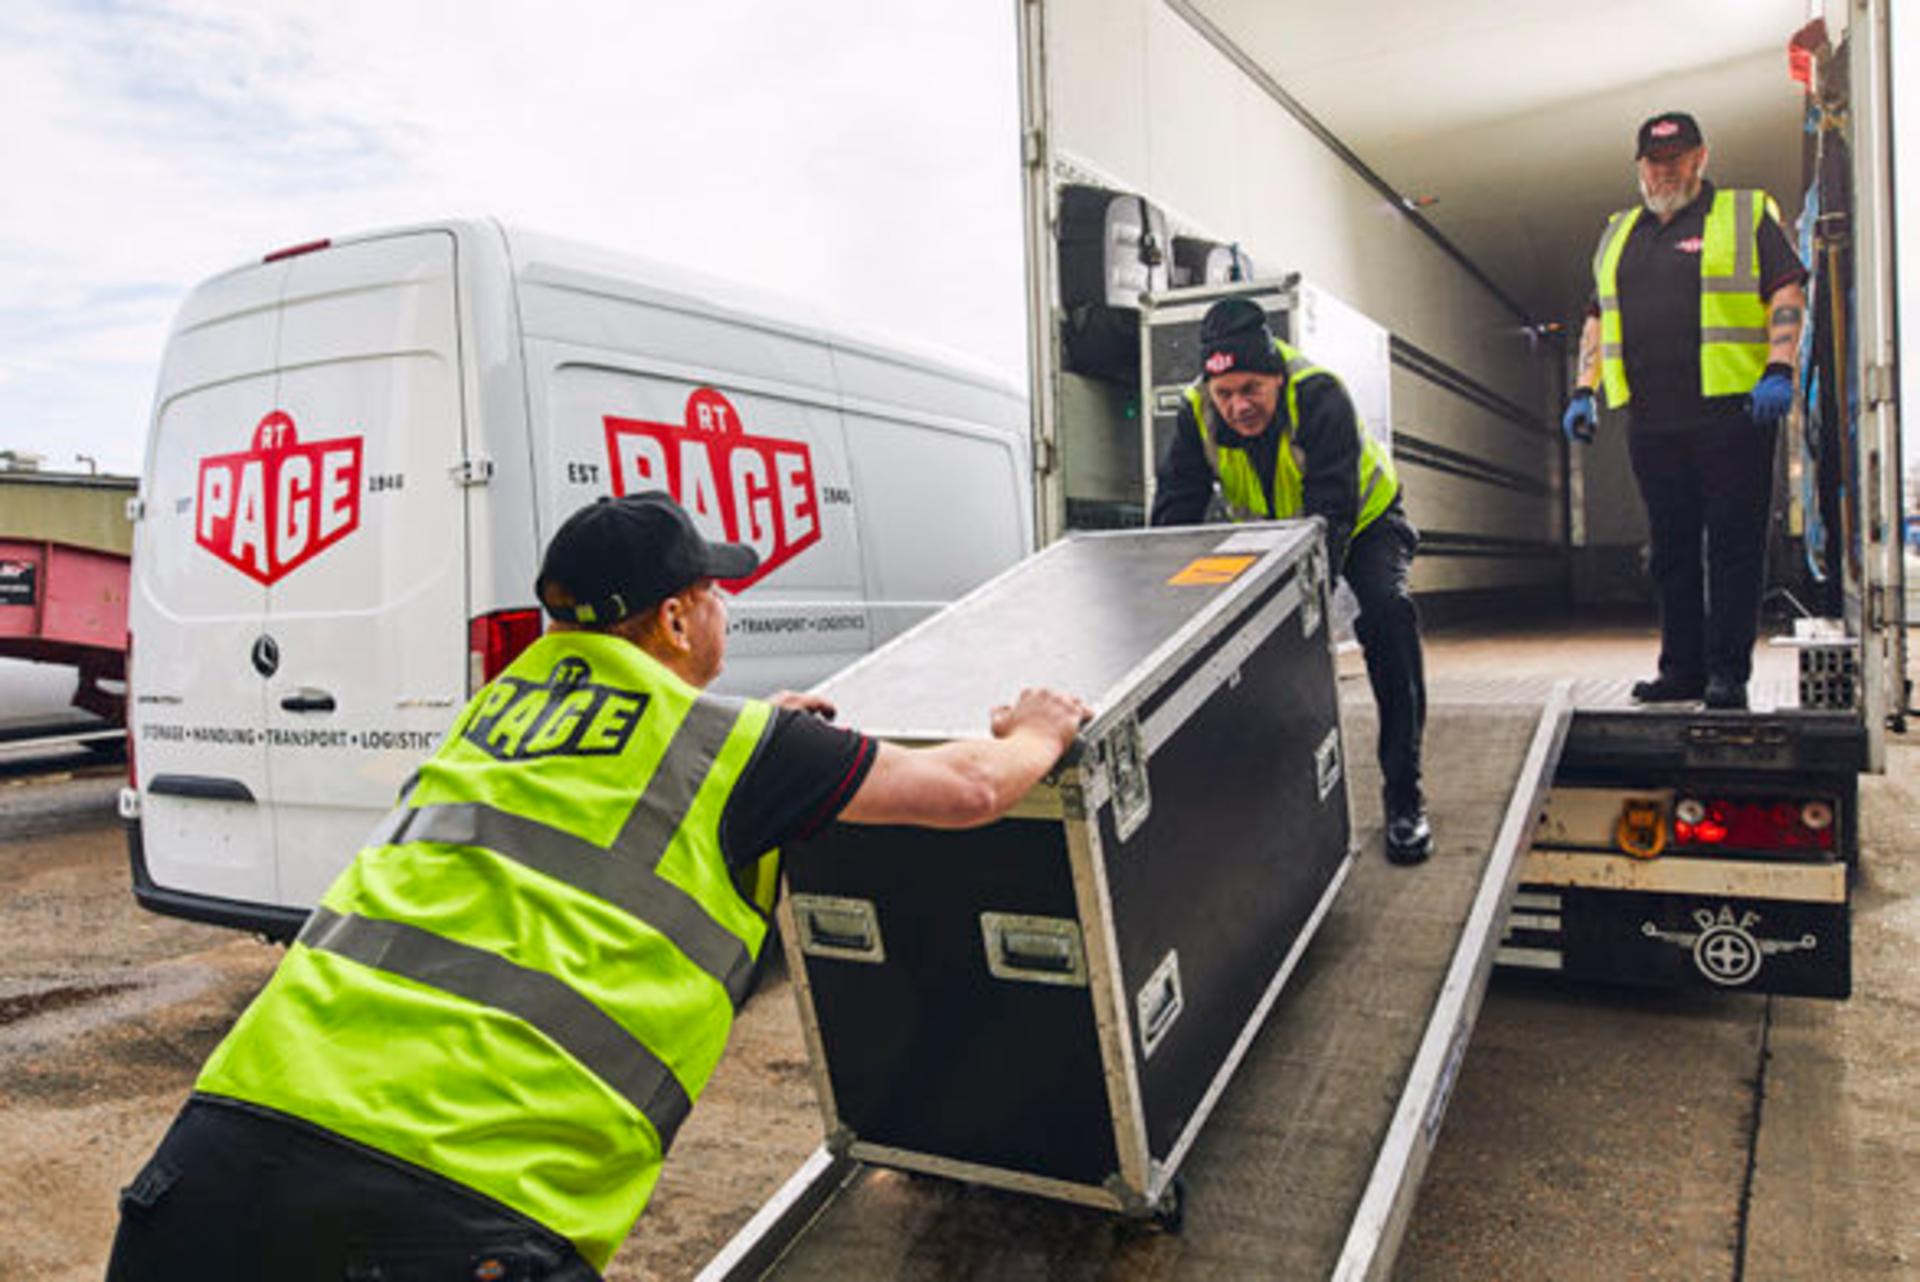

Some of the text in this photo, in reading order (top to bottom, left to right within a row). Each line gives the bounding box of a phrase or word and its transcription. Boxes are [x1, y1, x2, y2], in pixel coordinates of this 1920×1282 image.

[696, 403, 728, 433] RT
[261, 423, 288, 450] RT
[201, 449, 355, 576] PAGE
[568, 462, 599, 485] EST
[614, 431, 814, 567] PAGE
[466, 682, 640, 758] PAGE
[266, 728, 347, 748] TRANSPORT
[361, 730, 442, 750] LOGISTIC
[1692, 904, 1762, 931] DAF
